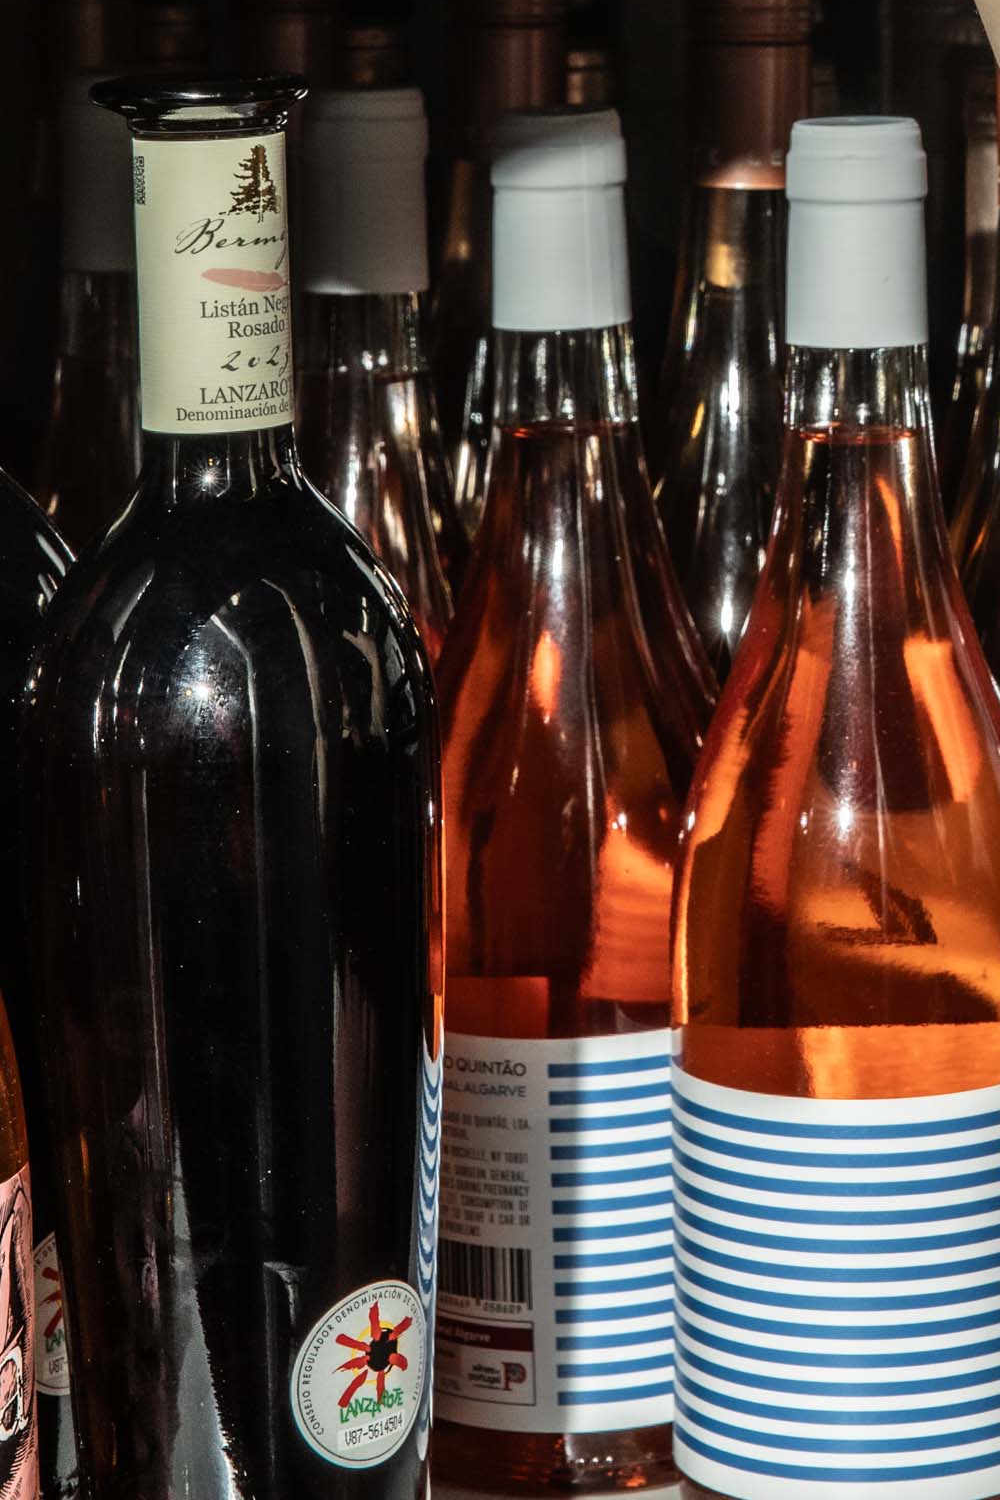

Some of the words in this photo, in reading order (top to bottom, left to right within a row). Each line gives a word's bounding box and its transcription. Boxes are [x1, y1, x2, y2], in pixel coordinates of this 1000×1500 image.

[200, 297, 260, 319] Listán
[228, 314, 286, 339] Rosado
[176, 401, 277, 422] Denominación
[456, 1058, 527, 1077] QUINTÃO
[463, 1083, 527, 1098] ALGARVE
[334, 1287, 403, 1324] DENOMINACIÓN
[302, 1322, 334, 1386] REGULADOR
[301, 1391, 325, 1437] CONSEJO
[339, 1387, 405, 1425] LANZAROTE
